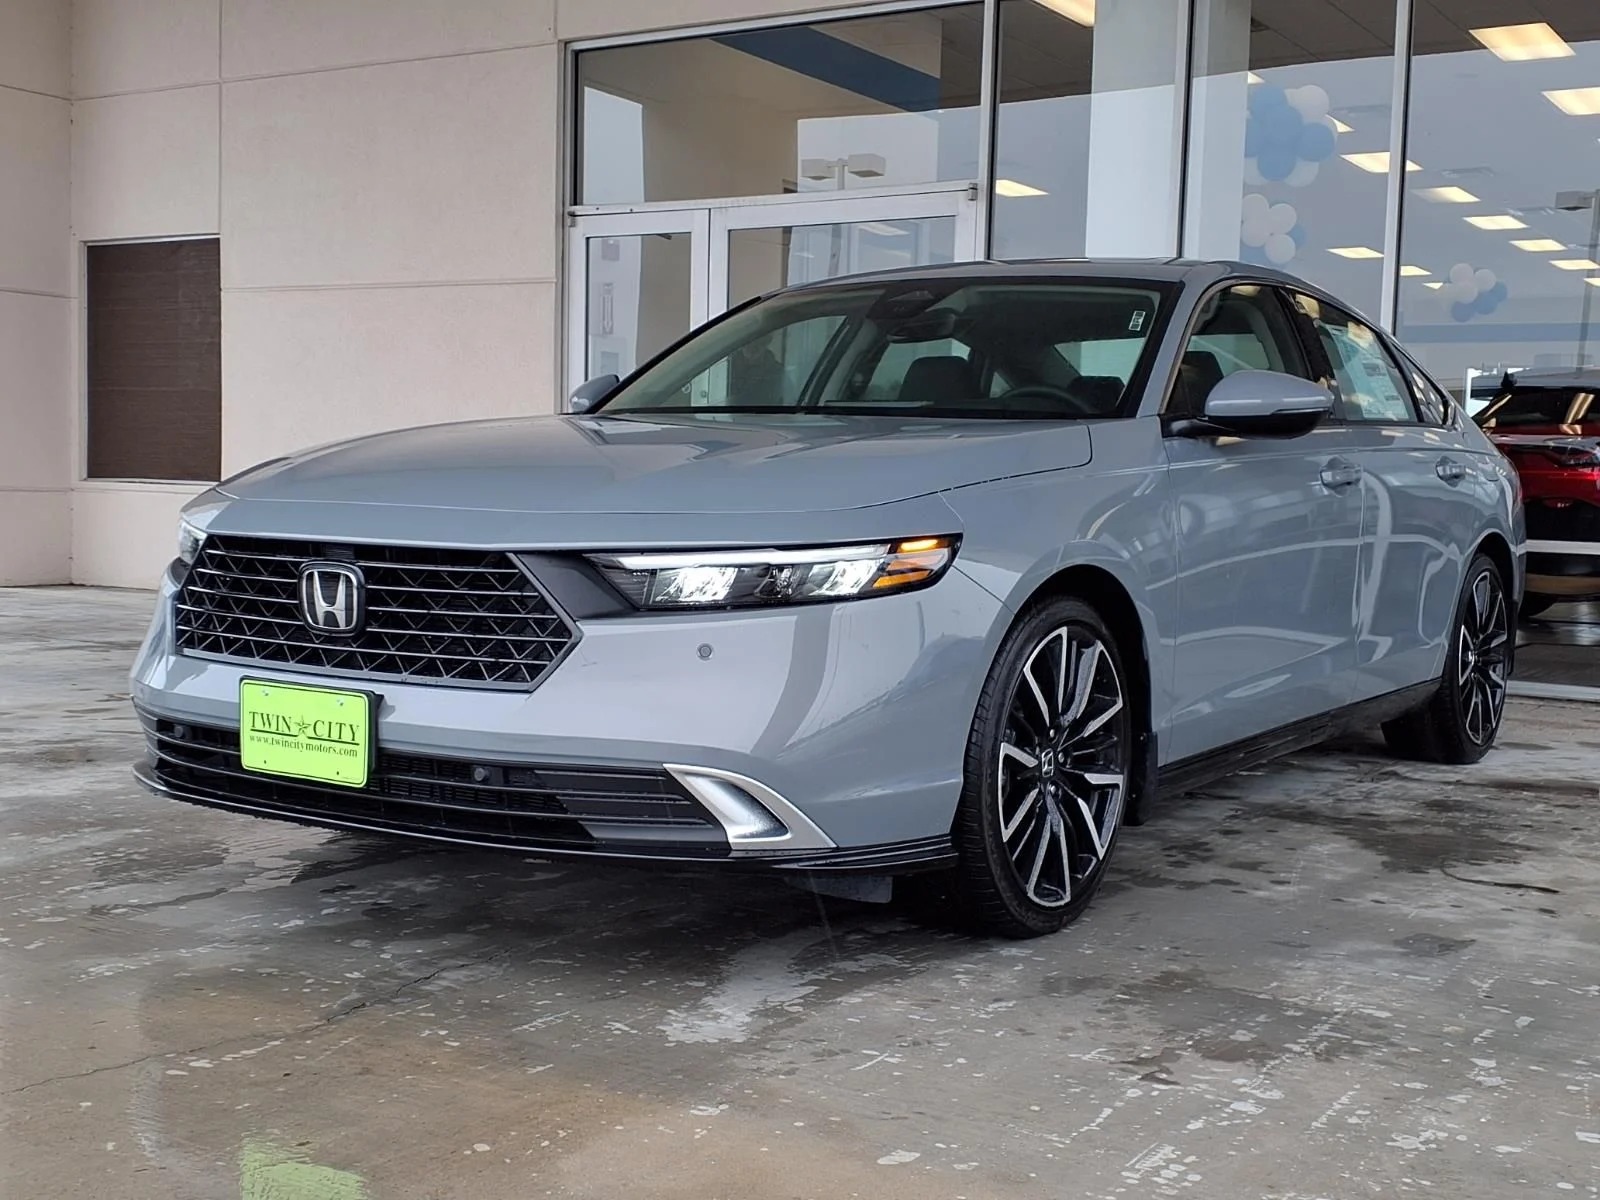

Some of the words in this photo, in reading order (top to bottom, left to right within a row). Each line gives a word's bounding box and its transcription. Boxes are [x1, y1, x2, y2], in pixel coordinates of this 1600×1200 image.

[249, 711, 292, 733] TWIN
[313, 719, 360, 742] CITY
[249, 735, 358, 758] www.twincitymotors.com
